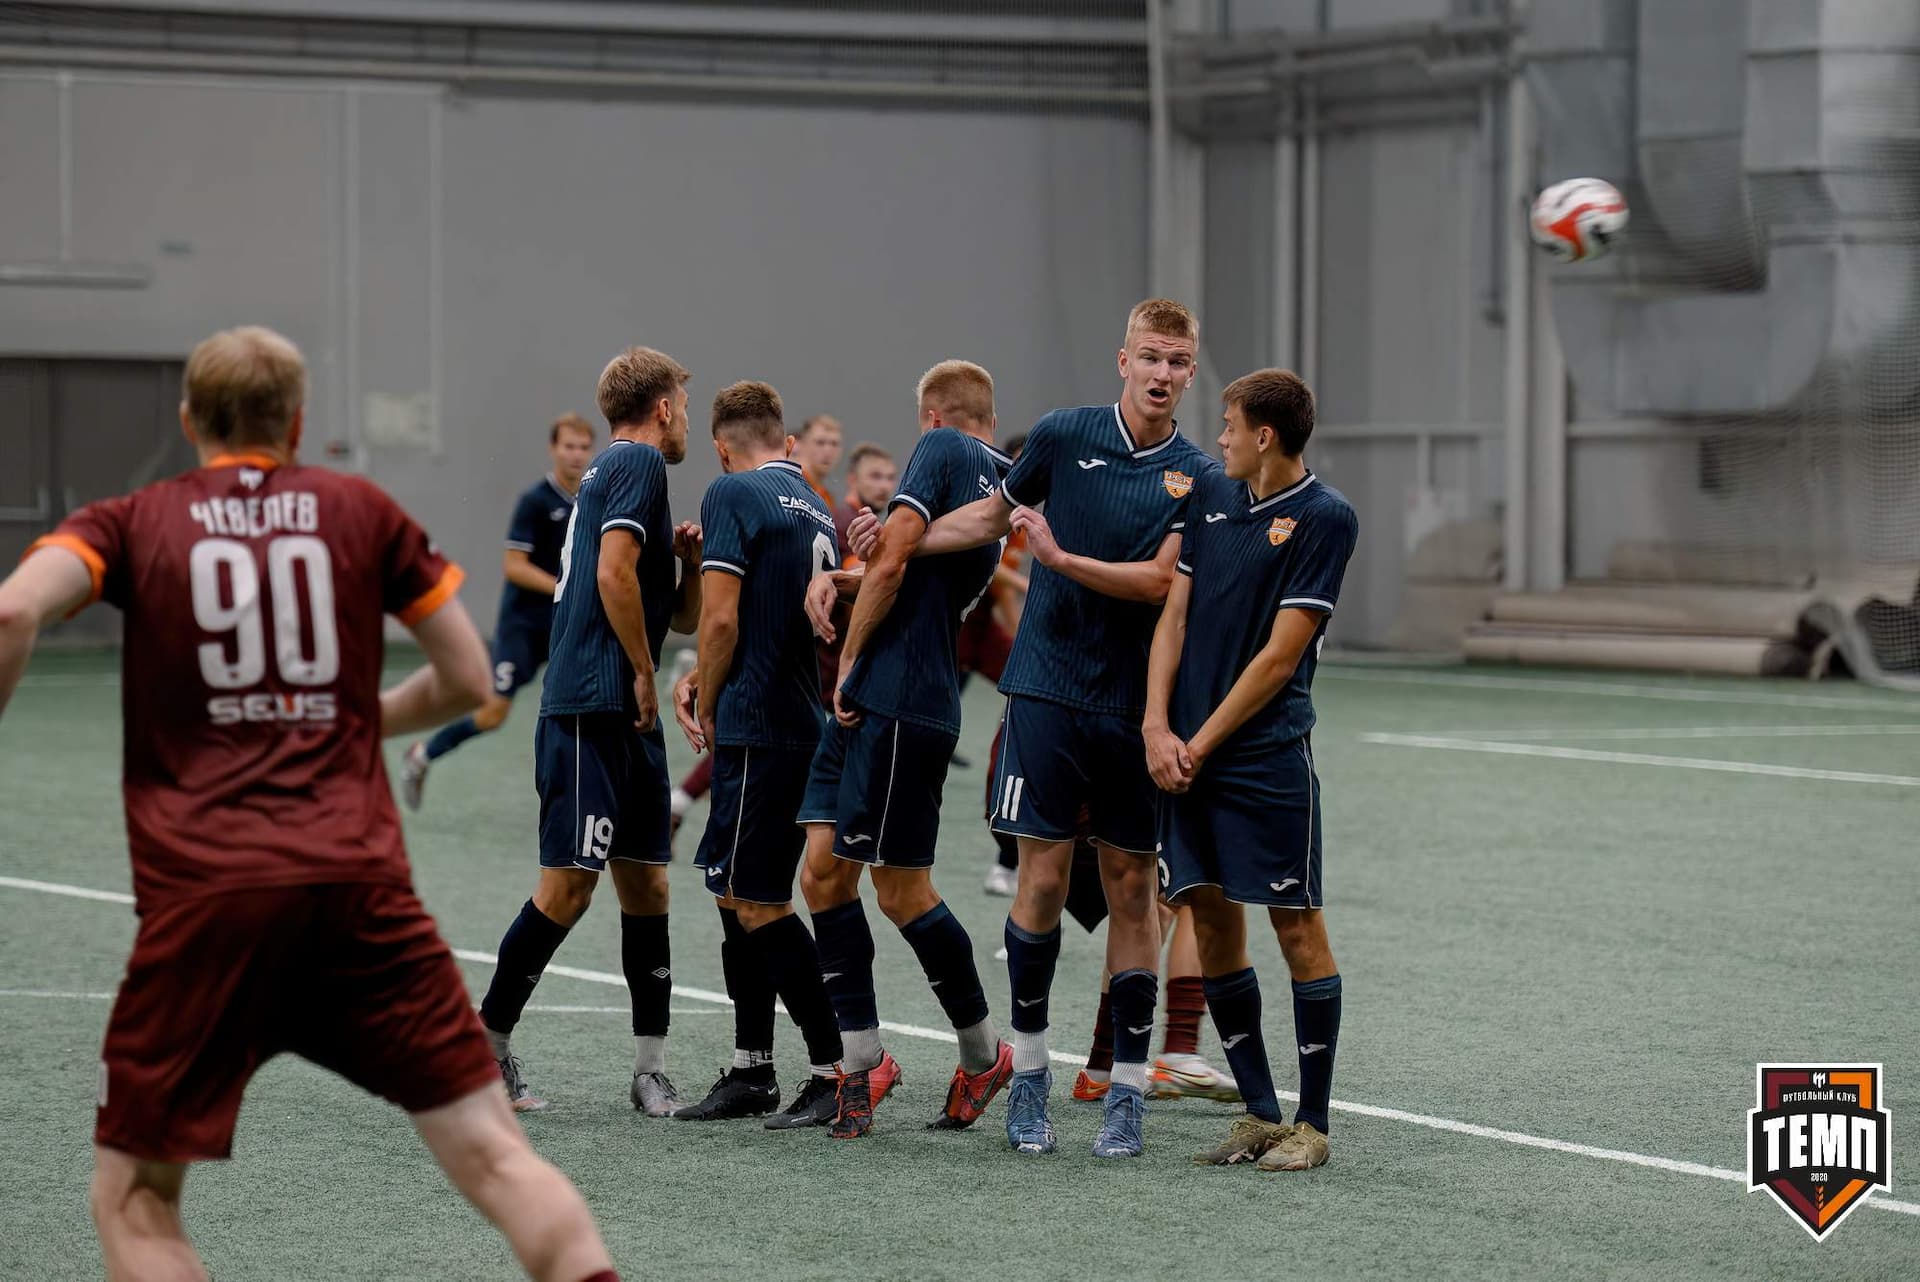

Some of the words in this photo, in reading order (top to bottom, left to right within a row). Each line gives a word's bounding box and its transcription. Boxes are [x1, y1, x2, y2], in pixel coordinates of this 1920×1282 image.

[189, 534, 340, 690] 90
[1001, 774, 1025, 822] 11
[582, 813, 615, 860] 19
